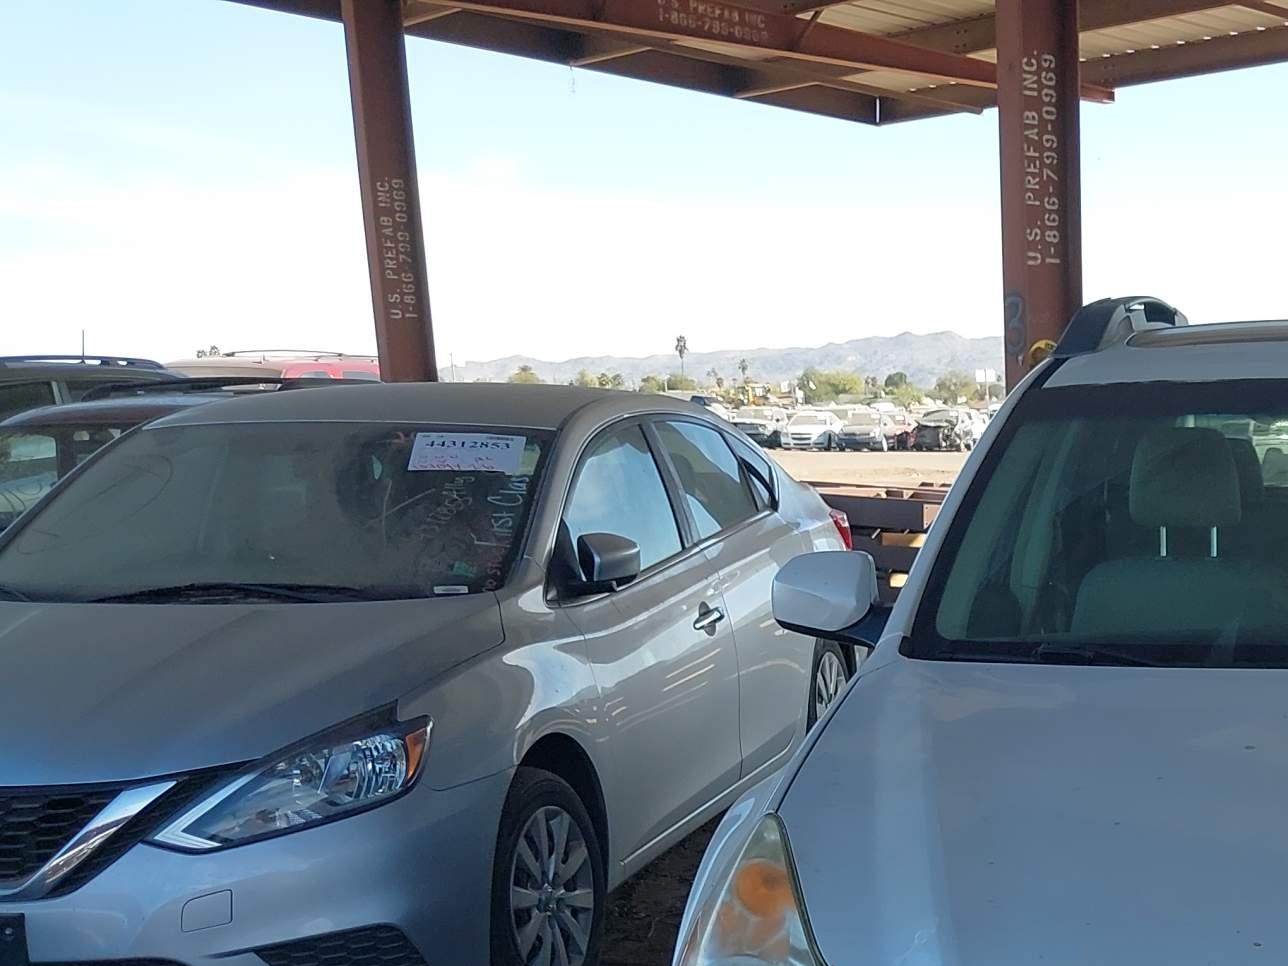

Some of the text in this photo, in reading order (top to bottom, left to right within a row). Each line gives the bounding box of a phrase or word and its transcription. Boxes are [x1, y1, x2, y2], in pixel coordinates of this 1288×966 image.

[1022, 50, 1041, 266] U.S. PREFAB INC.
[1041, 54, 1061, 265] 1-866-799-0969
[376, 176, 403, 319] U.S. PREFAB INC.
[391, 178, 418, 319] 1-866-799-0969
[424, 439, 512, 450] 44312853
